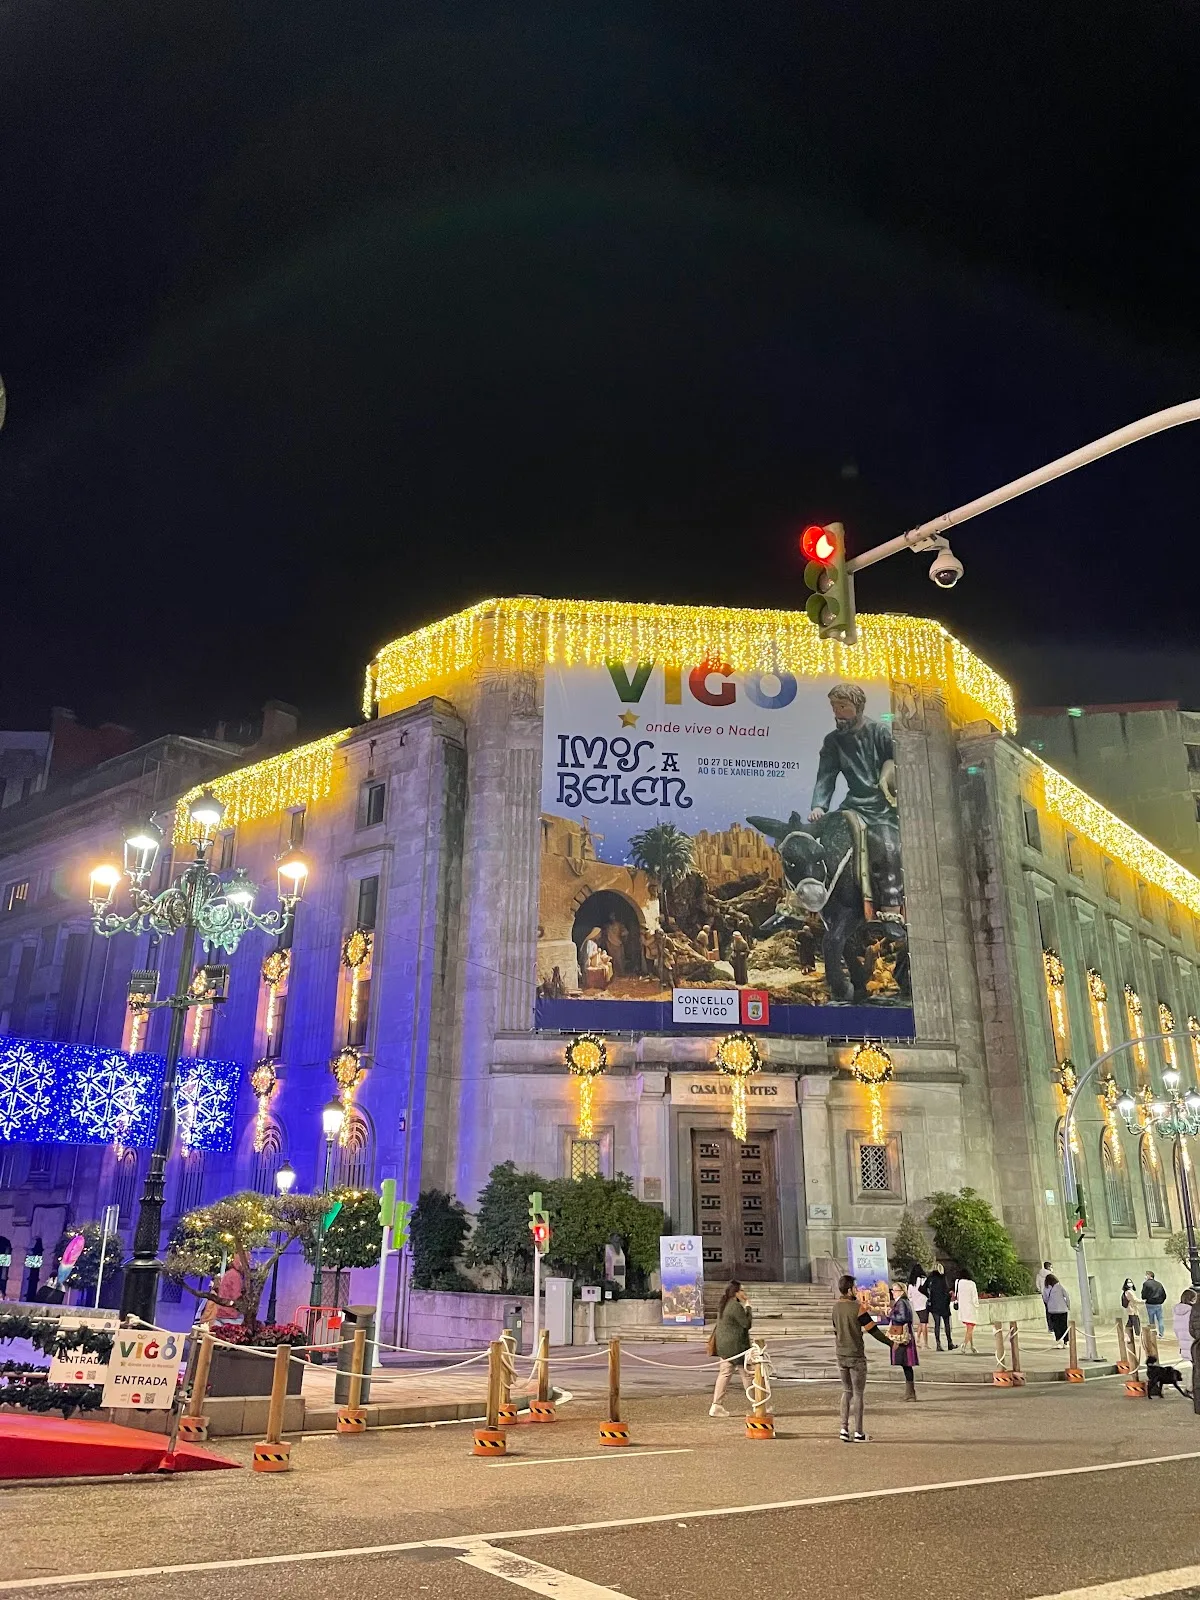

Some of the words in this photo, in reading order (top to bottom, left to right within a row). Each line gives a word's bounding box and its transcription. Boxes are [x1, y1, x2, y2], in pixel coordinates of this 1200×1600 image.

[604, 655, 798, 710] VIGO
[645, 721, 680, 733] onde
[684, 722, 712, 735] vive
[716, 726, 724, 735] o
[728, 724, 770, 737] Nadal
[557, 734, 654, 772] IMOS
[661, 752, 680, 772] A
[697, 757, 709, 766] DO
[711, 758, 721, 766] 27
[723, 758, 733, 767] DE
[735, 759, 780, 769] NOVEMBRO
[781, 761, 800, 770] 2021
[697, 766, 709, 775] AO
[711, 767, 716, 775] 6
[718, 767, 728, 775] DE
[730, 768, 765, 777] XANEIRO
[766, 769, 785, 778] 2022
[556, 765, 693, 809] BELÉN
[677, 995, 734, 1005] CONCELLO
[684, 1006, 698, 1015] DE
[702, 1007, 727, 1016] VIGO
[690, 1084, 717, 1095] CASA
[744, 1085, 778, 1096] ARTES
[669, 1240, 694, 1251] VIGO
[859, 1242, 881, 1252] VIGO
[120, 1337, 177, 1360] VIGO
[59, 1355, 101, 1365] ENTRAD
[114, 1374, 168, 1387] ENTRADA
